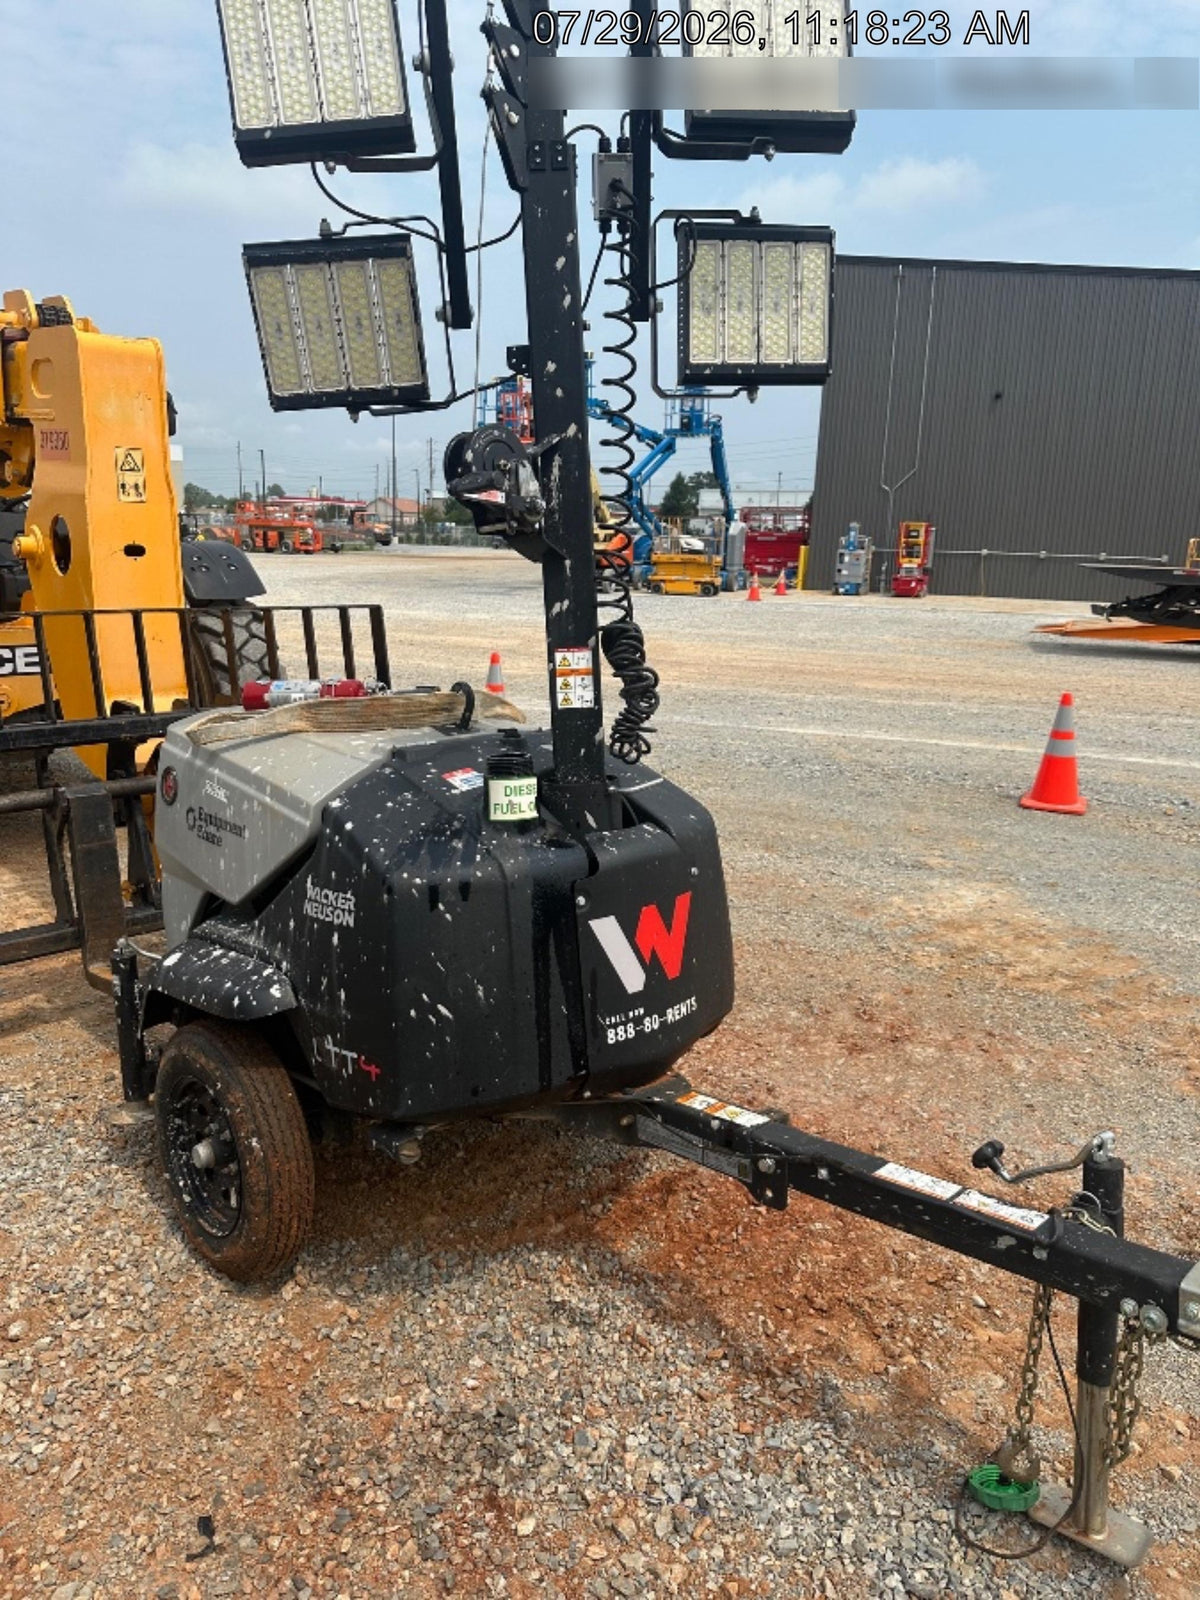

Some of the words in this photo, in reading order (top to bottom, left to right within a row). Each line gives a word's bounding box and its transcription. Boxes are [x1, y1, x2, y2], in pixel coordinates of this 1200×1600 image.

[493, 801, 527, 815] FUEL
[306, 880, 356, 911] WACKER
[303, 899, 355, 928] NEUSON
[606, 995, 698, 1045] 888-80-RENTS
